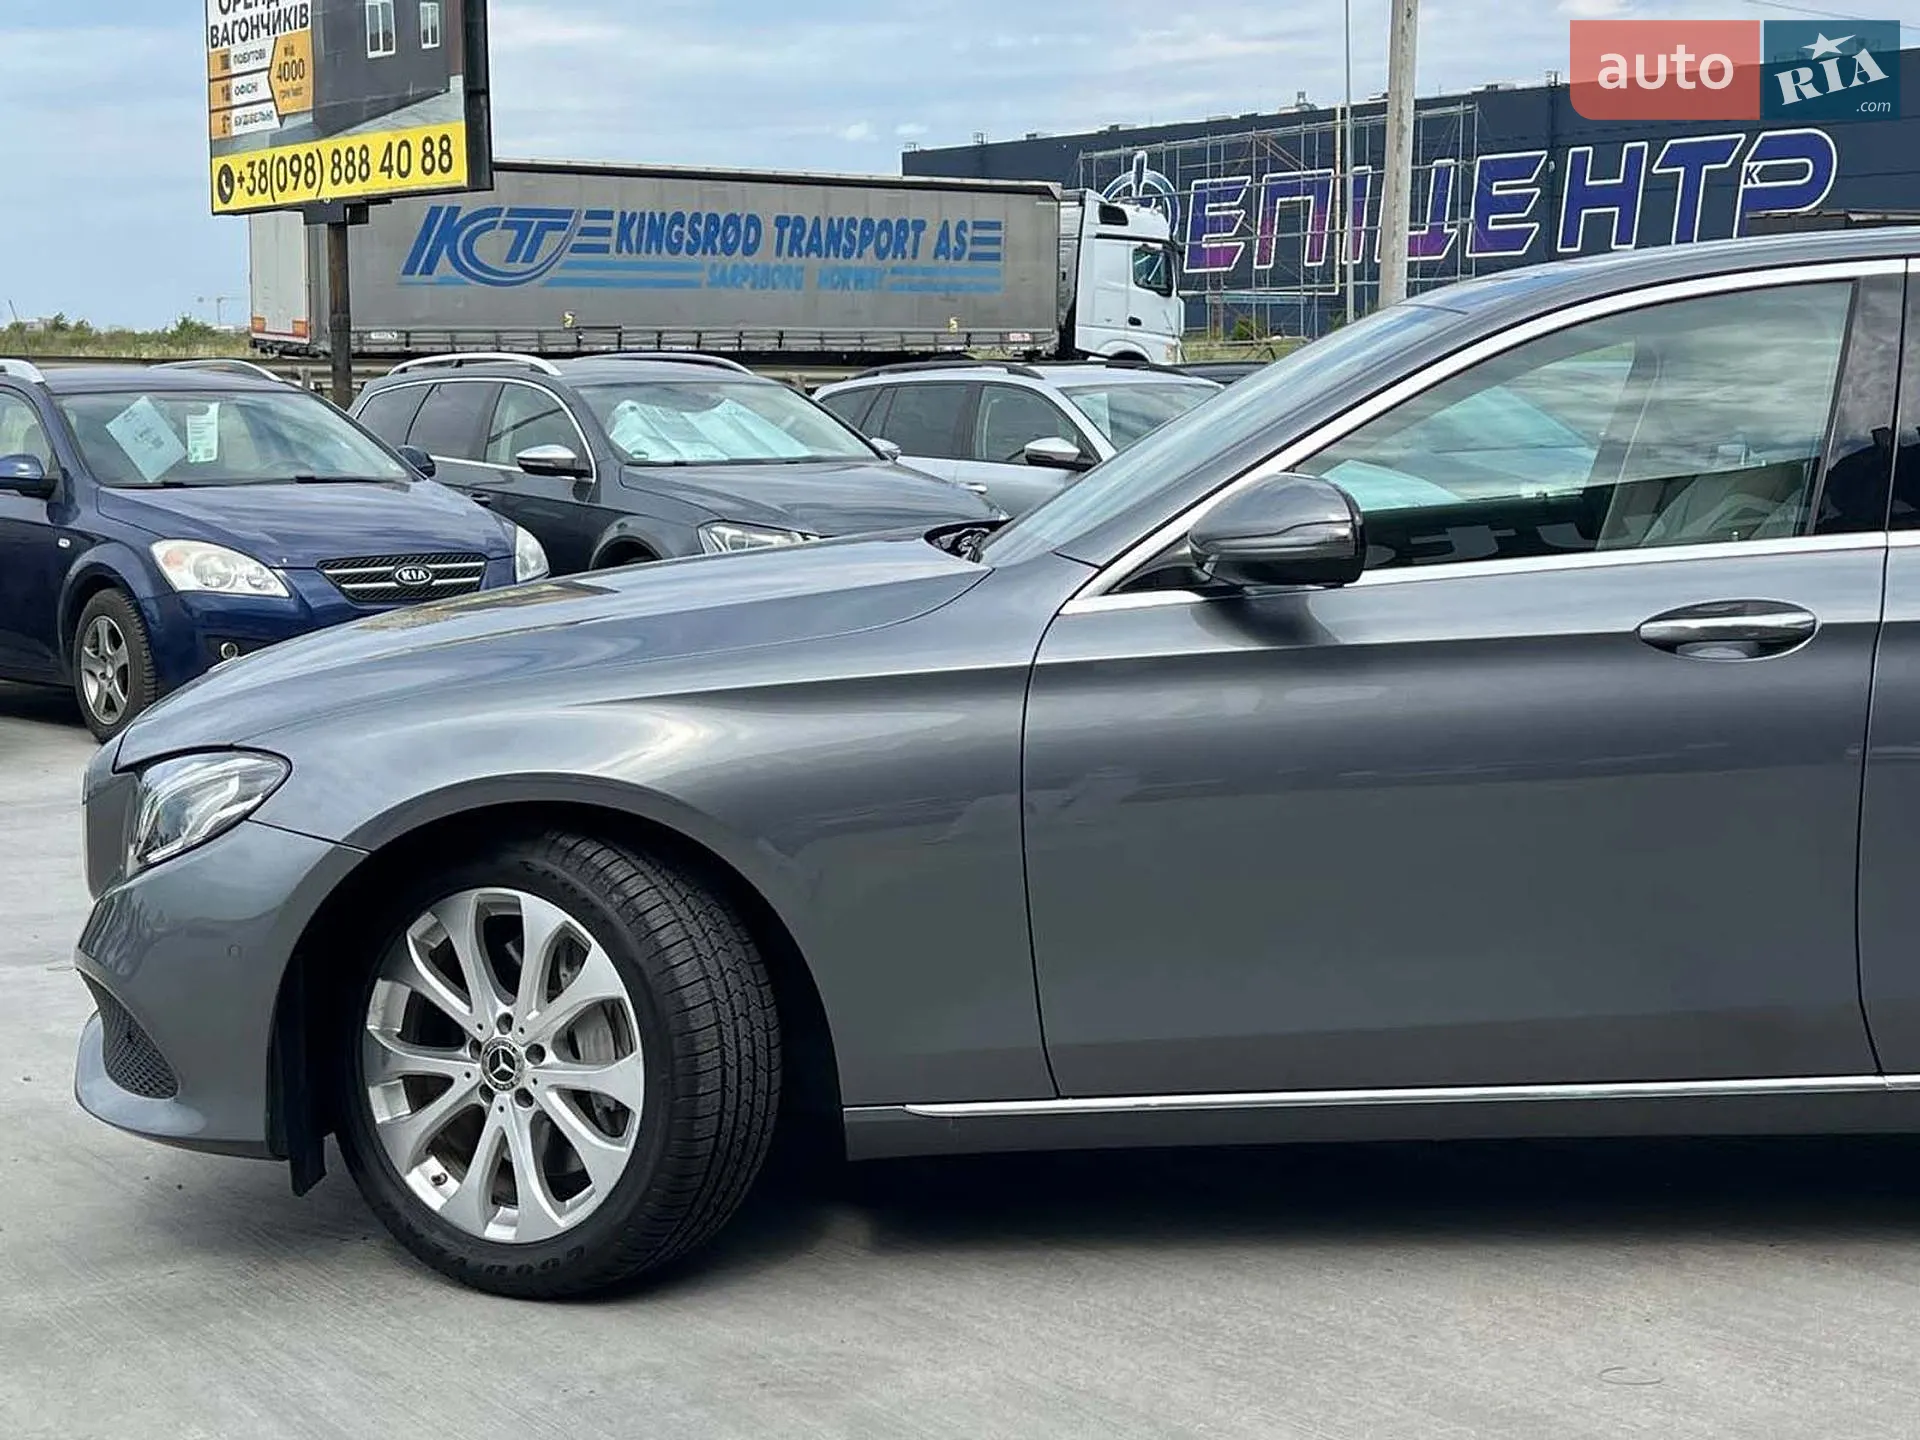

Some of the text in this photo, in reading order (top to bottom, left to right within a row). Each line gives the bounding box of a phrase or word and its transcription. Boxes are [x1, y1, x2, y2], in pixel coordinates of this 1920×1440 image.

[210, 3, 309, 49] ВАГОНЧИКІВ
[276, 58, 305, 82] 4000
[236, 134, 453, 203] +38(098) 888 40 88
[1183, 128, 1837, 274] ЕПІЦЕНТР
[615, 210, 763, 256] KINGSRØD
[774, 214, 927, 261] TRANSPORT
[933, 219, 969, 261] AS
[400, 568, 428, 581] KIA
